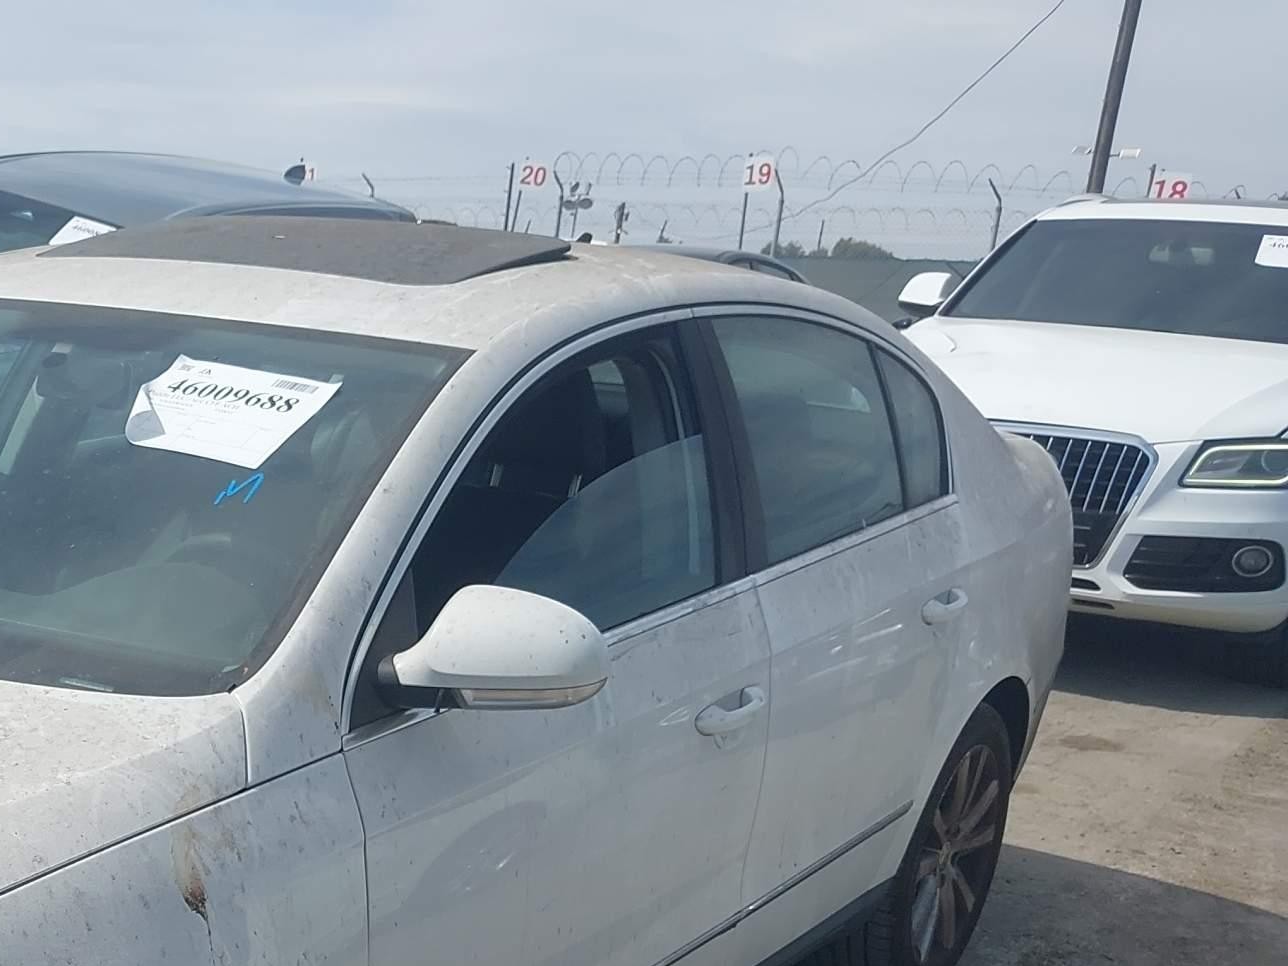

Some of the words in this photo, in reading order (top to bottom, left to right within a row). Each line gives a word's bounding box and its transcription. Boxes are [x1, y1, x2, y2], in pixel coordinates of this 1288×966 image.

[520, 165, 547, 186] 20
[744, 163, 772, 185] 19
[1154, 180, 1188, 199] 18
[167, 378, 300, 413] 46009688
